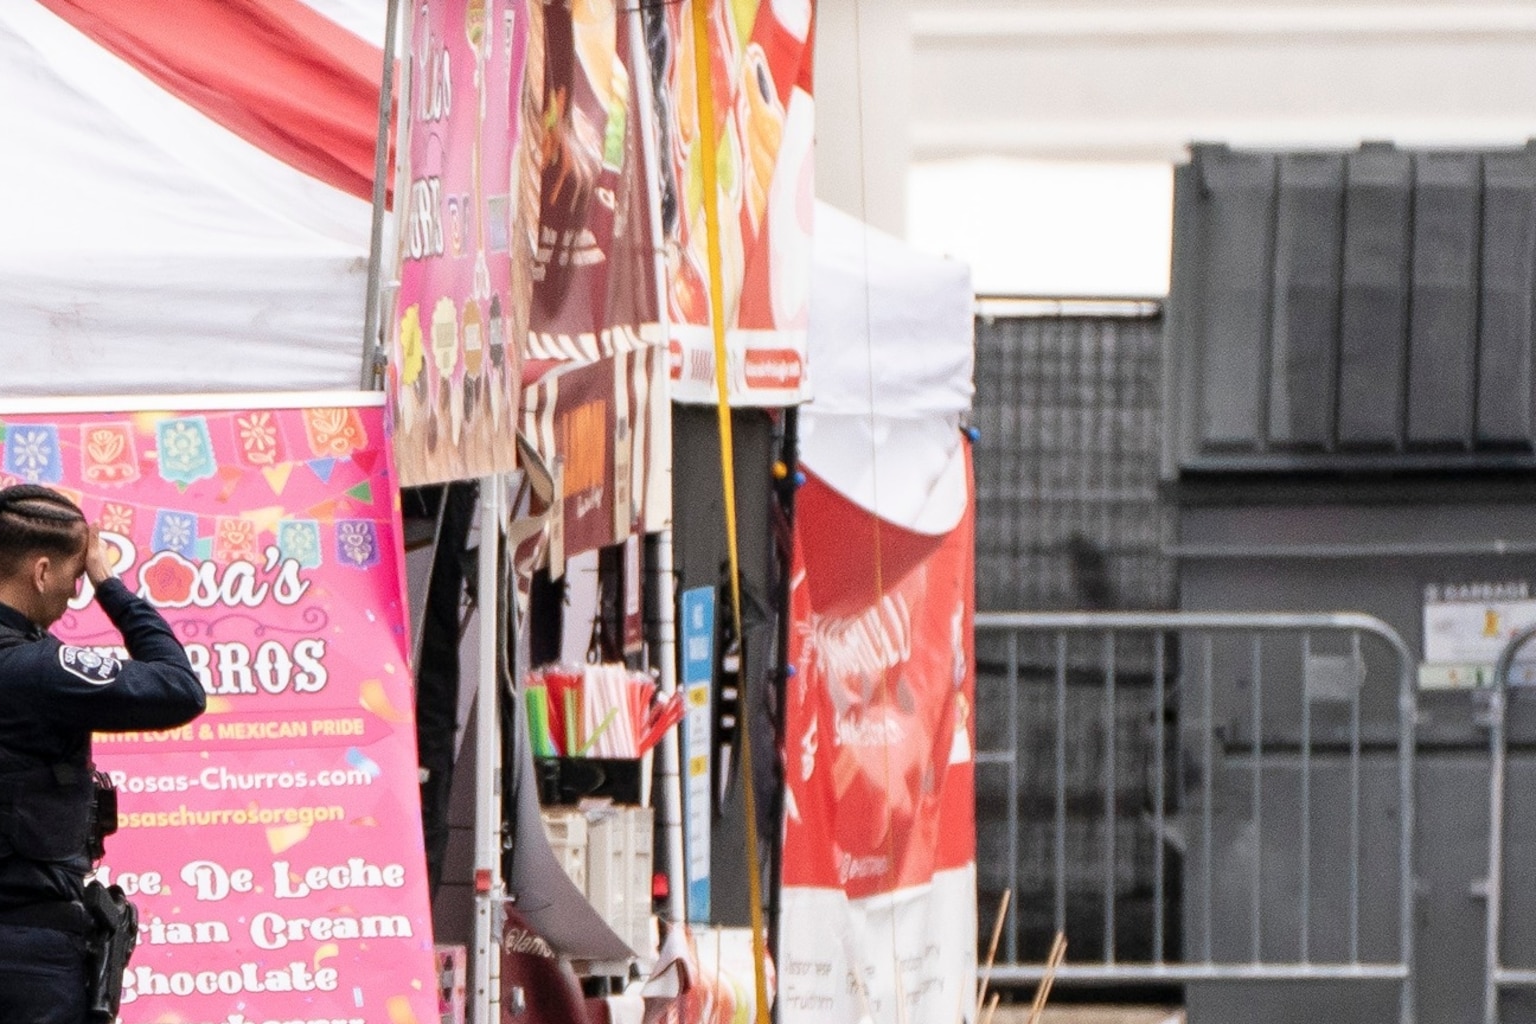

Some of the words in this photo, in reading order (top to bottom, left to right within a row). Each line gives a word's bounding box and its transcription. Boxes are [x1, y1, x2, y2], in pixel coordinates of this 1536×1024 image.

[143, 723, 194, 742] LOVE
[198, 723, 214, 741] &
[218, 720, 308, 741] MEXICAN
[312, 717, 365, 736] PRIDE
[117, 803, 345, 830] osaschurrosoregon
[85, 864, 162, 897] lce
[180, 859, 254, 902] De
[272, 856, 406, 900] Leche
[135, 917, 231, 947] rian
[249, 911, 413, 950] Cream
